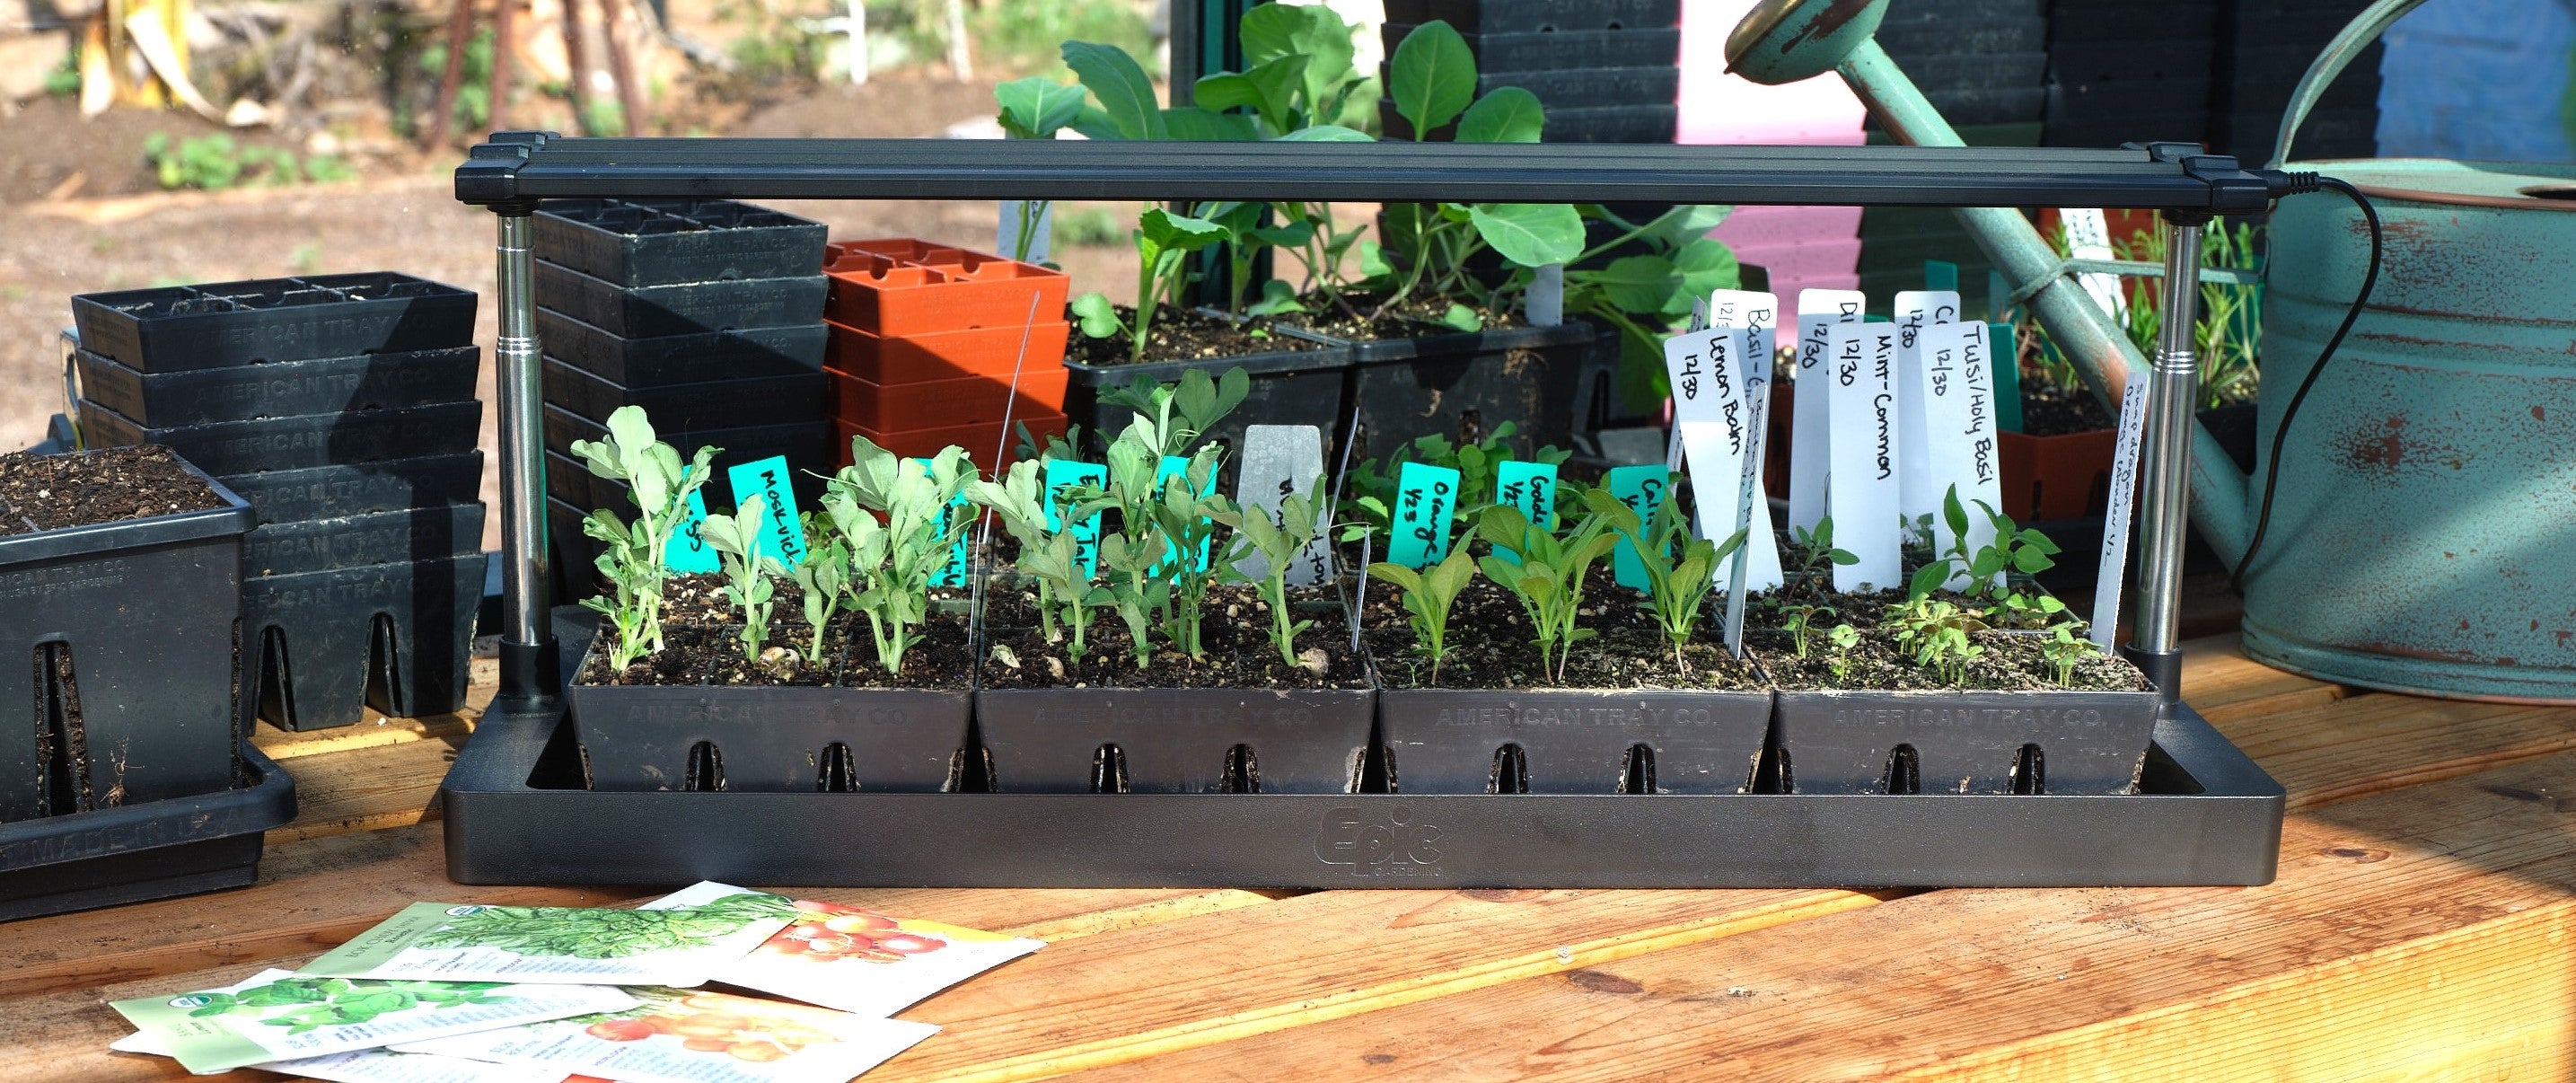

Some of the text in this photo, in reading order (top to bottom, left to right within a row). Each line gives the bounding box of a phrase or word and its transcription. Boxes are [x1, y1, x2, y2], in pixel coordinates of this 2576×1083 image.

[192, 321, 318, 348] AMERICAN
[324, 315, 391, 338] TRAY
[1747, 307, 1771, 359] Basil
[1801, 323, 1828, 370] 12/30
[1901, 309, 1923, 349] 12/30
[1680, 354, 1701, 401] 12/30
[1839, 338, 1862, 387] 12/30
[1930, 348, 1954, 397] 12/30
[194, 375, 321, 404] AMERICAN
[1709, 335, 1742, 456] Lemon Balm
[199, 431, 324, 456] AMERICAN
[1974, 436, 1992, 486] Basil
[331, 476, 397, 498] TRAY
[1403, 488, 1423, 524] 1/23
[1530, 475, 1550, 525] Golde
[50, 563, 101, 581] TRAY
[1435, 708, 1719, 727] AMERICAN TRAY CO.
[1833, 709, 1974, 727] AMERICAN
[1981, 709, 2057, 727] TRAY
[31, 826, 127, 863] MADE
[135, 818, 167, 846] IN
[1313, 804, 1445, 877] Epic
[1374, 867, 1441, 877] GARDENING
